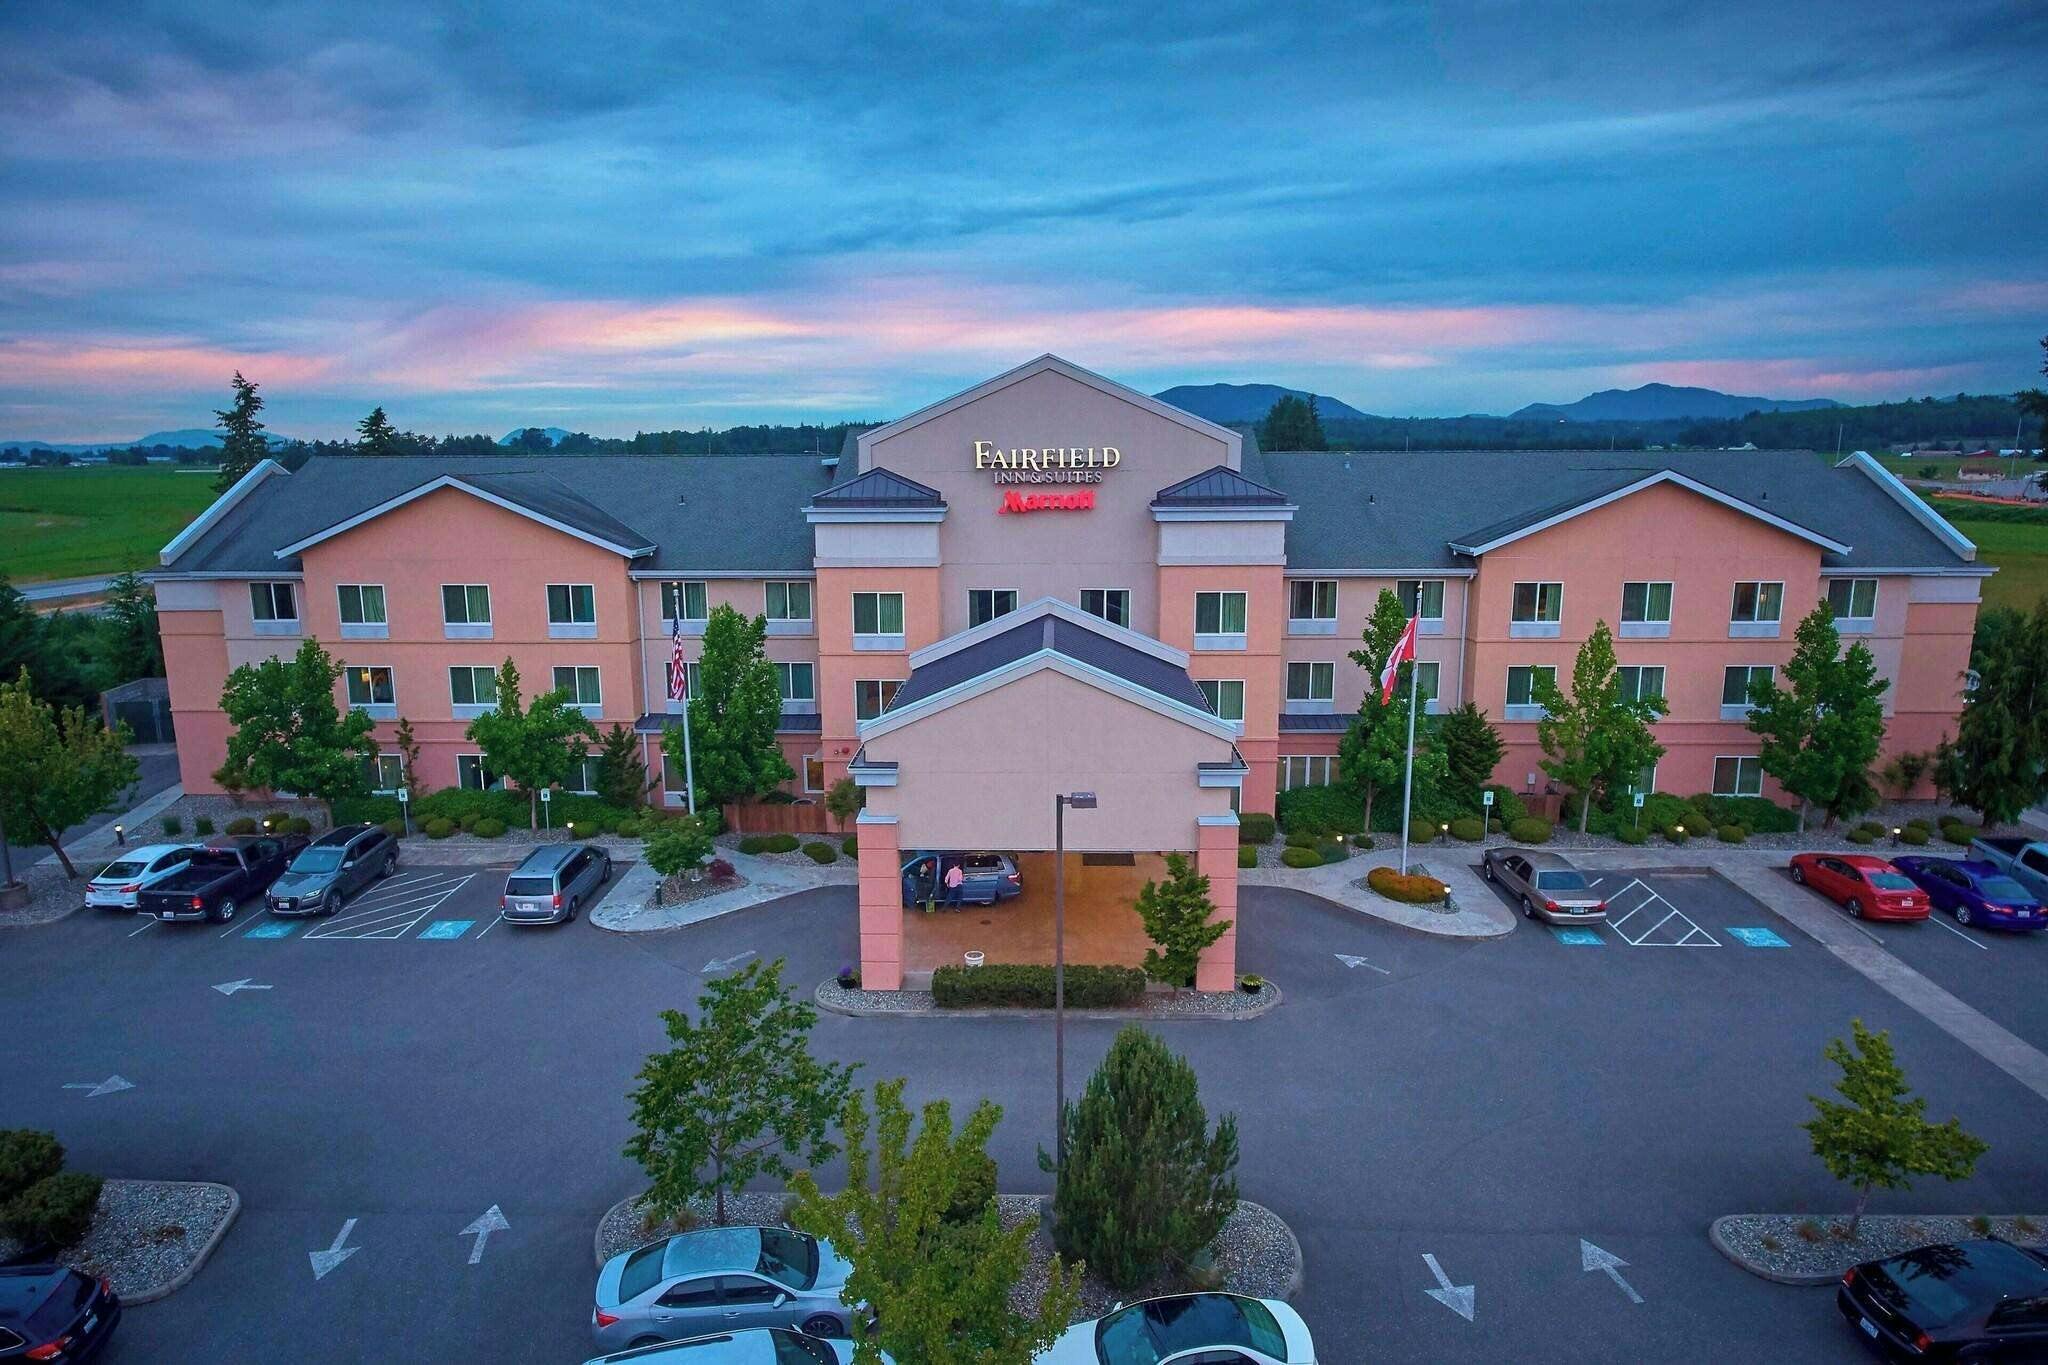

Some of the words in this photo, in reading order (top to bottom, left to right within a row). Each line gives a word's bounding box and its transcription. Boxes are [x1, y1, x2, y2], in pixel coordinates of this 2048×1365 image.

[974, 440, 1121, 471] FAIRFIELD
[994, 472, 1026, 484] INN
[1030, 471, 1042, 484] &
[1045, 471, 1103, 484] SUITES
